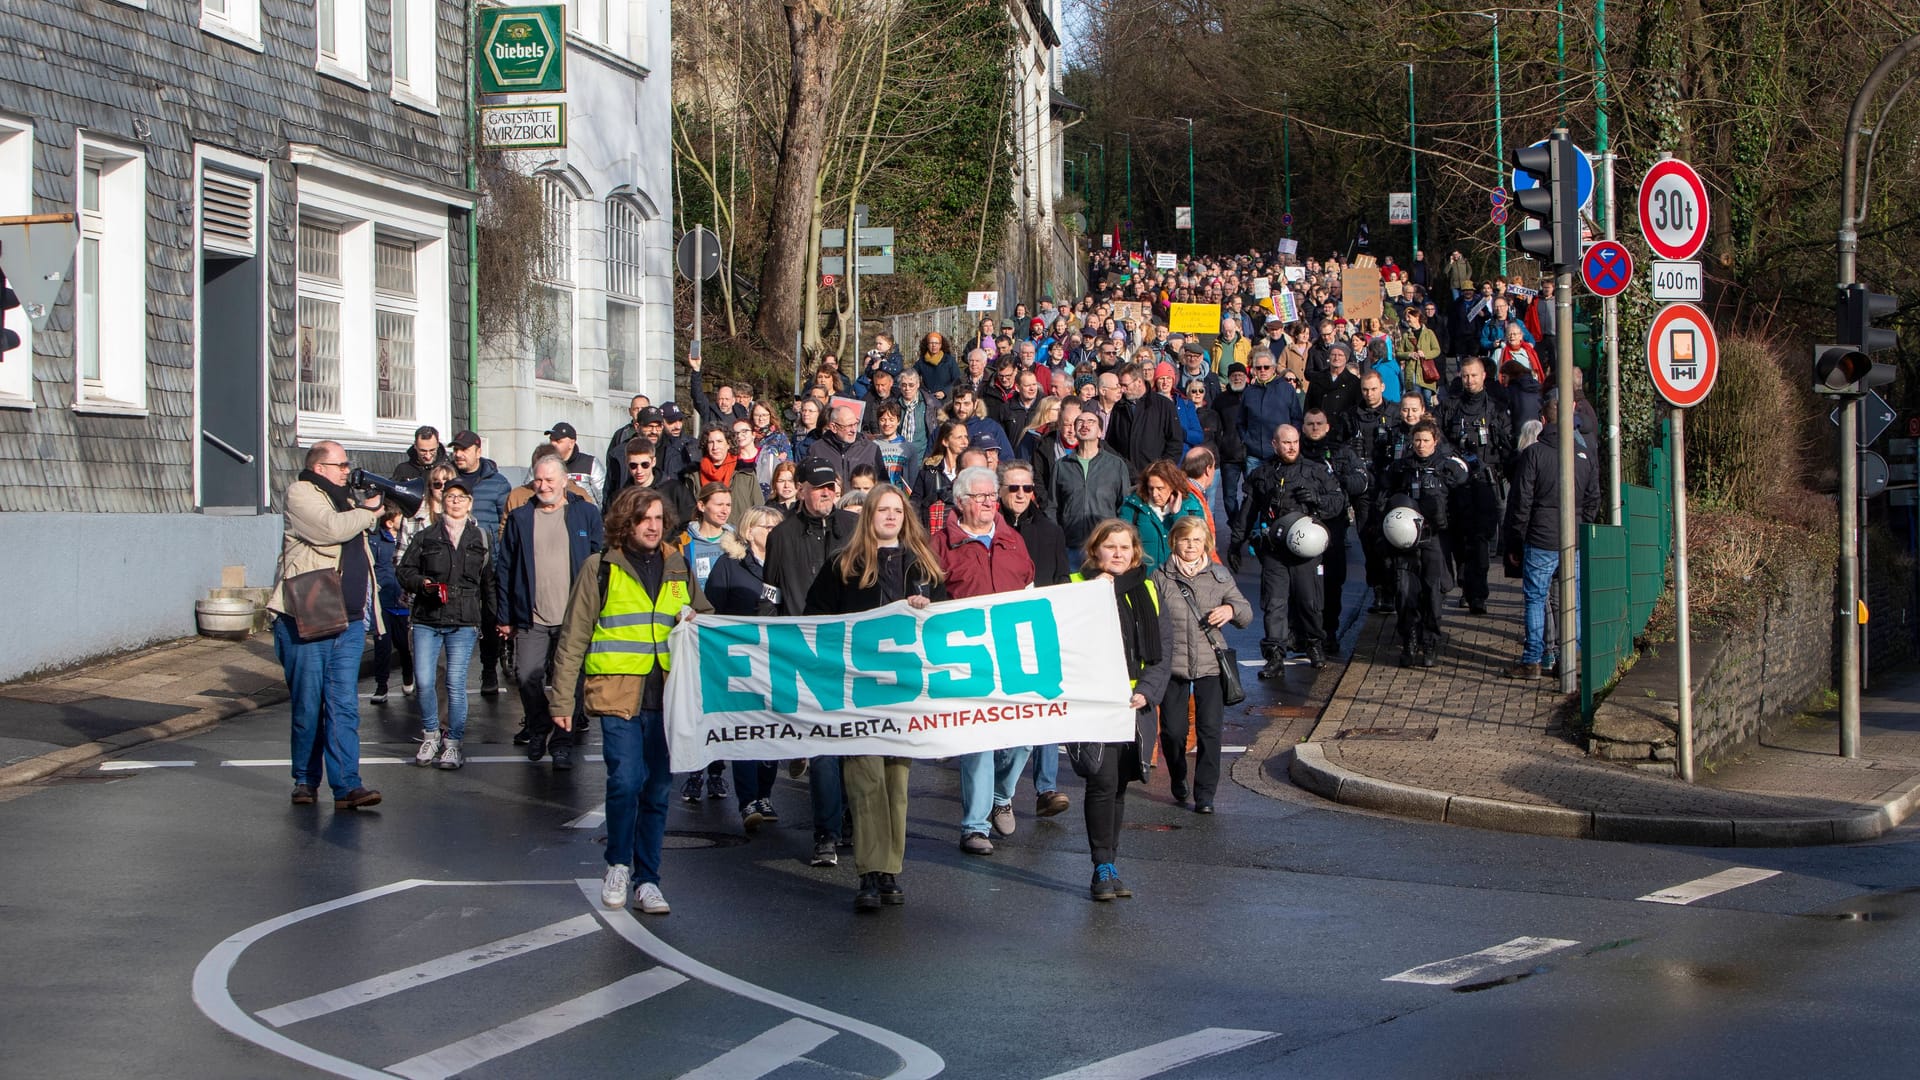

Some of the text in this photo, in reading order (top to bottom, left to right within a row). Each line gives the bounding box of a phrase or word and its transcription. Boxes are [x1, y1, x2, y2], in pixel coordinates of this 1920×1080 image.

[488, 109, 552, 125] GASTSTÄTTE
[1654, 189, 1694, 231] 30t
[1657, 271, 1698, 290] 400m
[698, 598, 1064, 714] ENSSQ
[706, 702, 1068, 746] ALERTA, ALERTA, ANTIFASCISTA!
